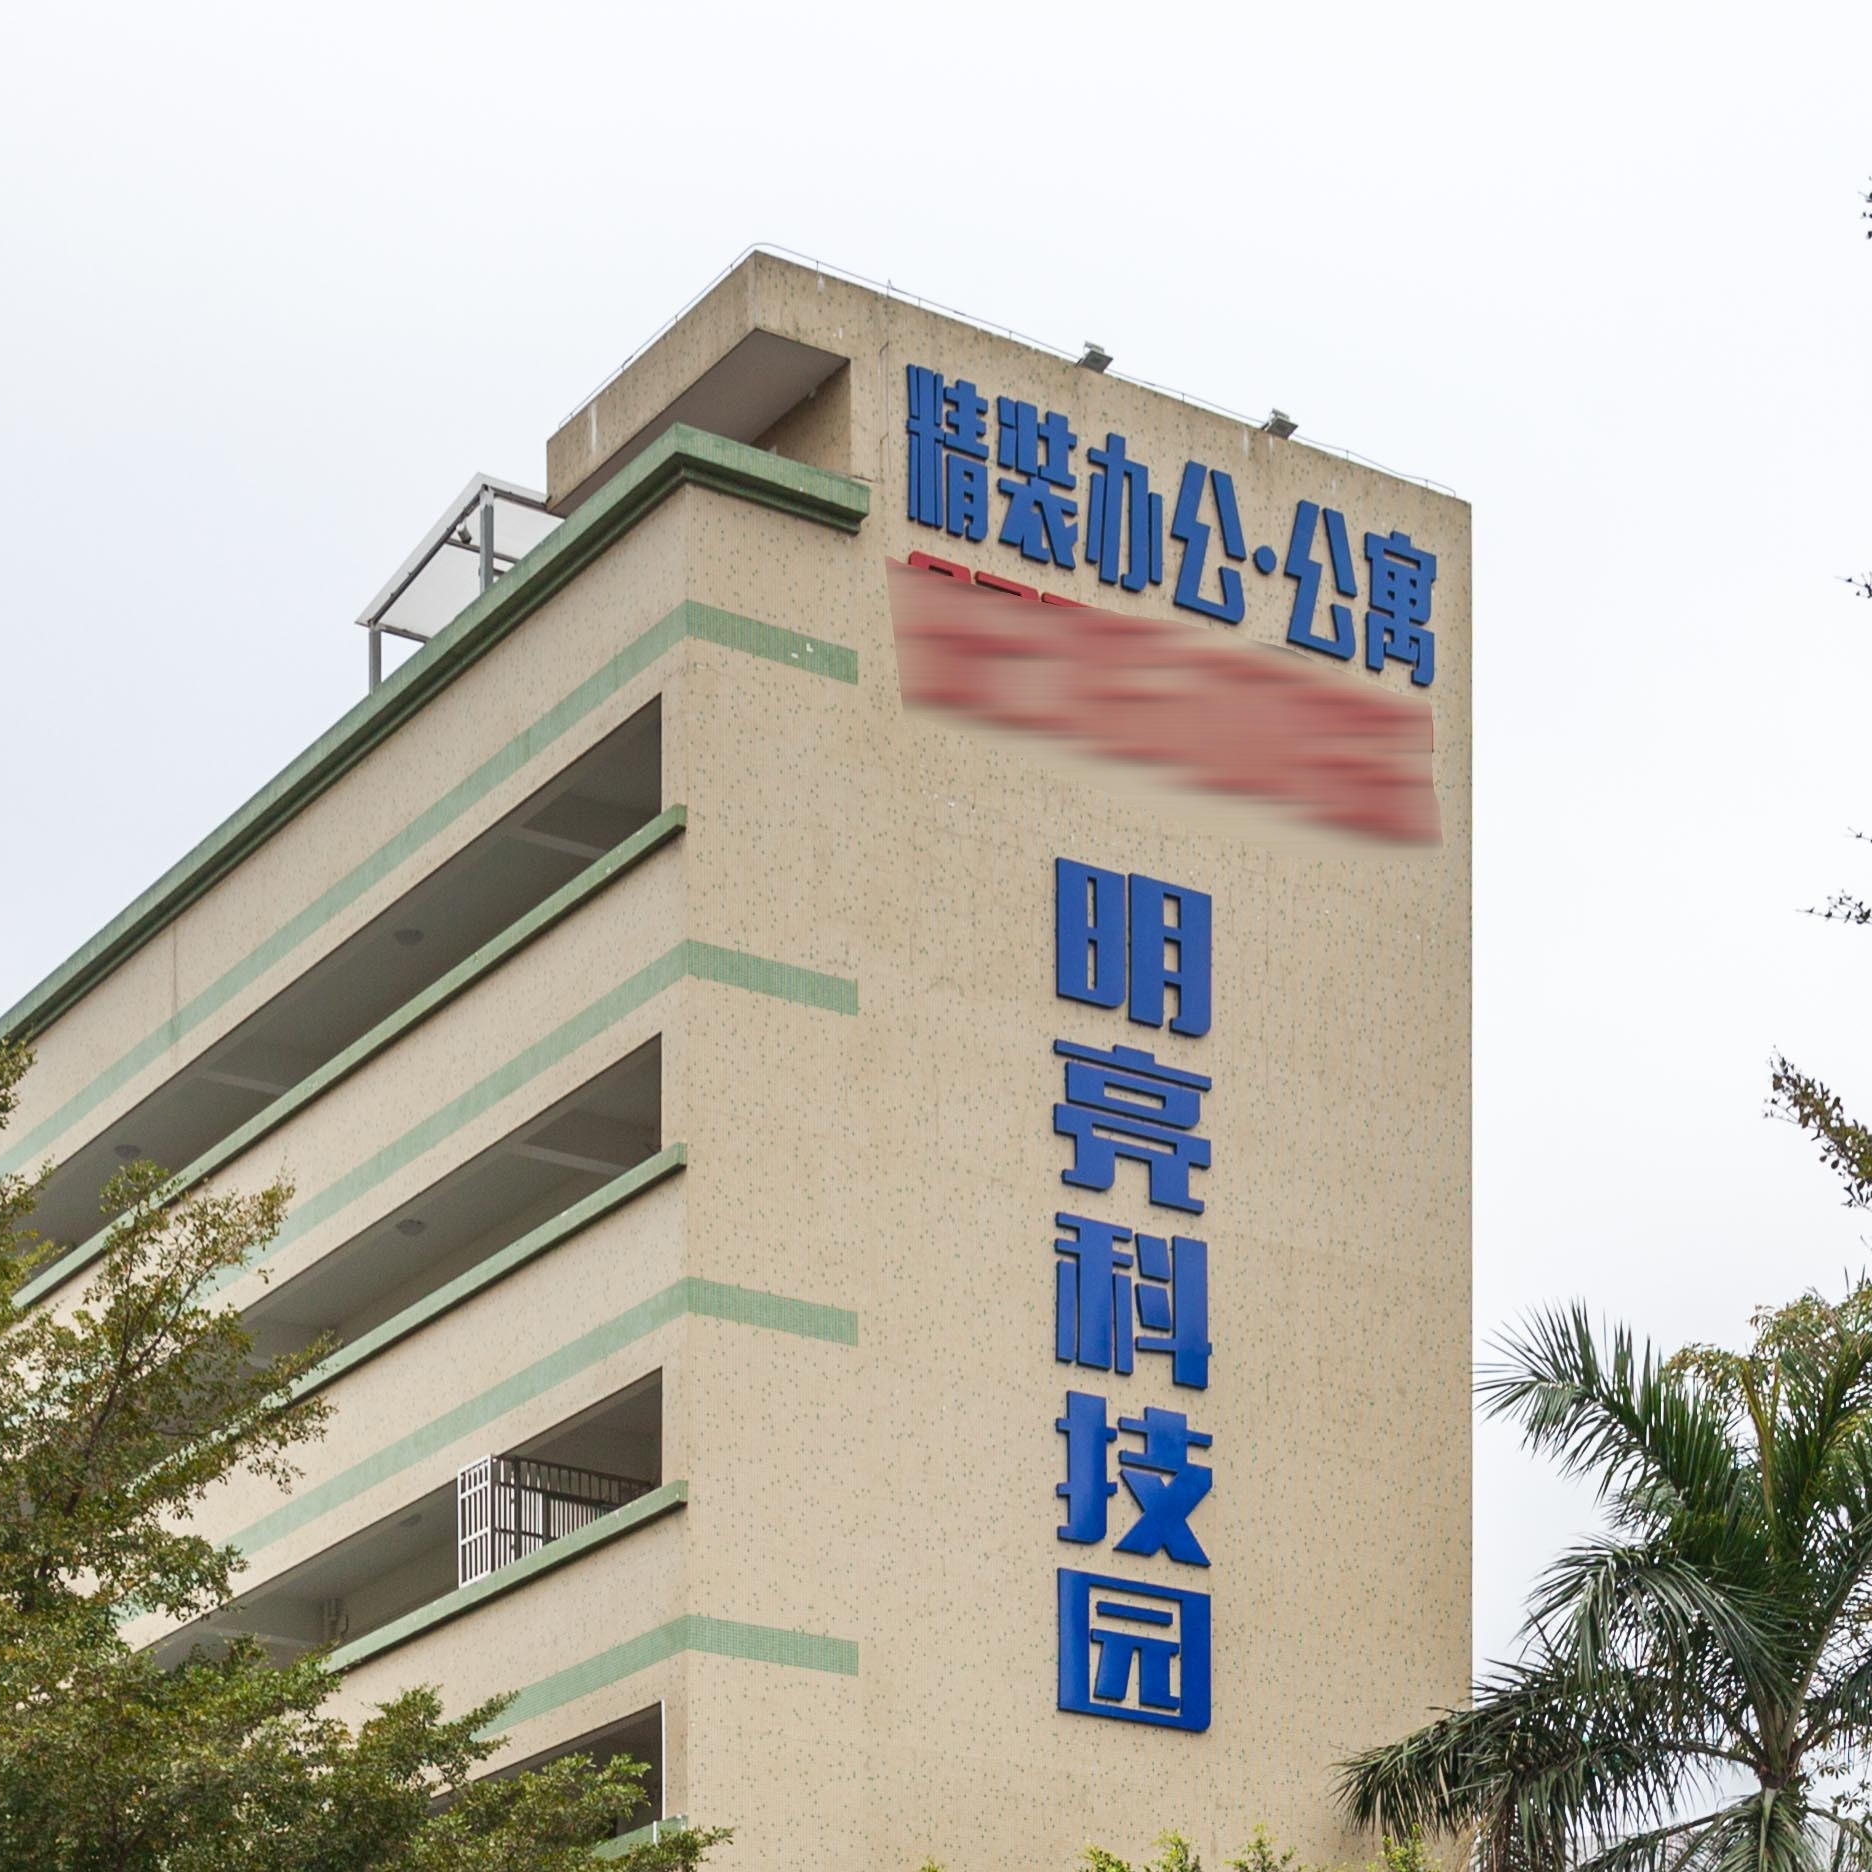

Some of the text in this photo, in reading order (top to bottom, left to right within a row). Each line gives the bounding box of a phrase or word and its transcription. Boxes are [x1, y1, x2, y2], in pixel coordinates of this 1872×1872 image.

[1053, 856, 1212, 1733] 明亮科技园
